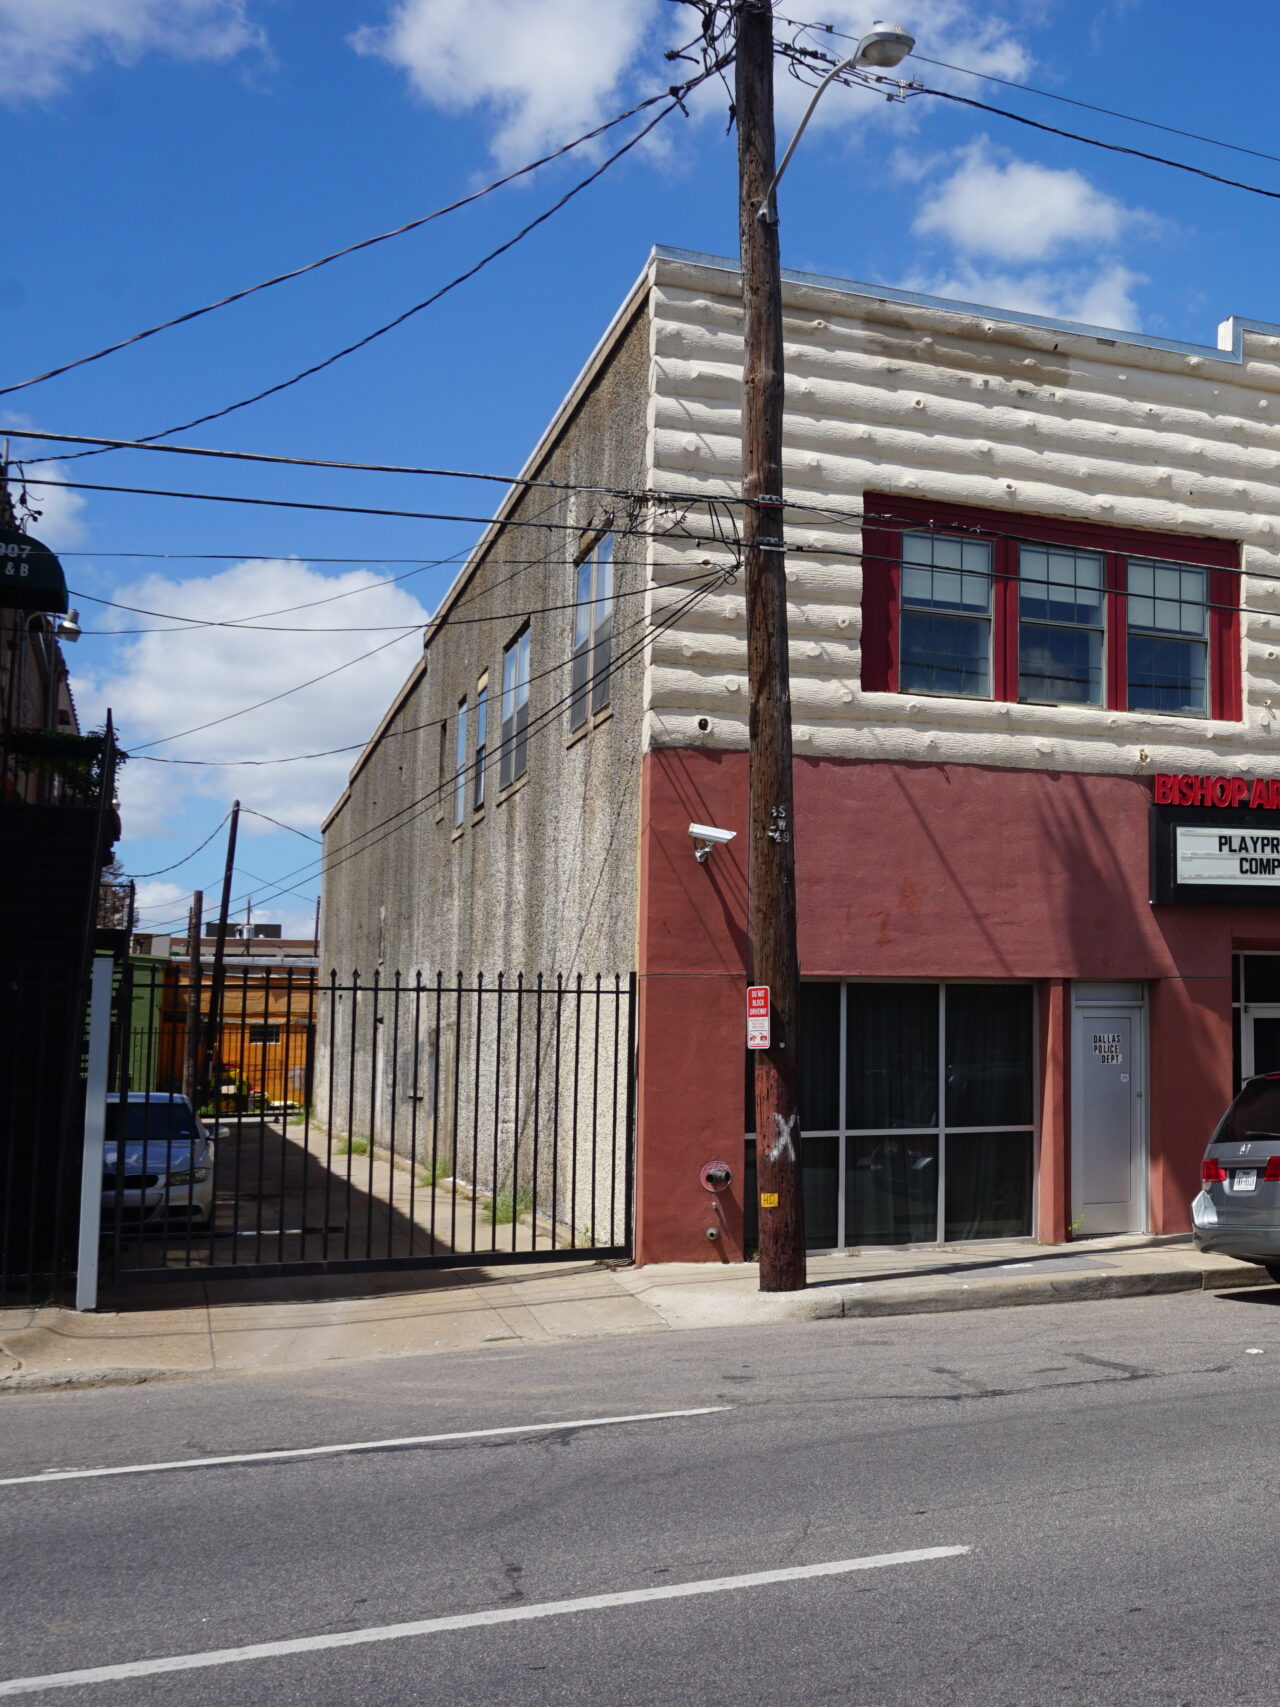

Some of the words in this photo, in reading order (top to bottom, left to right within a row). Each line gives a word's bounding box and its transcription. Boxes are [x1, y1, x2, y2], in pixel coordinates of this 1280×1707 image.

[20, 563, 29, 576] B
[1155, 773, 1247, 807] BISHOP
[1093, 1034, 1121, 1044] DALLAS
[1093, 1044, 1119, 1054] POLICE
